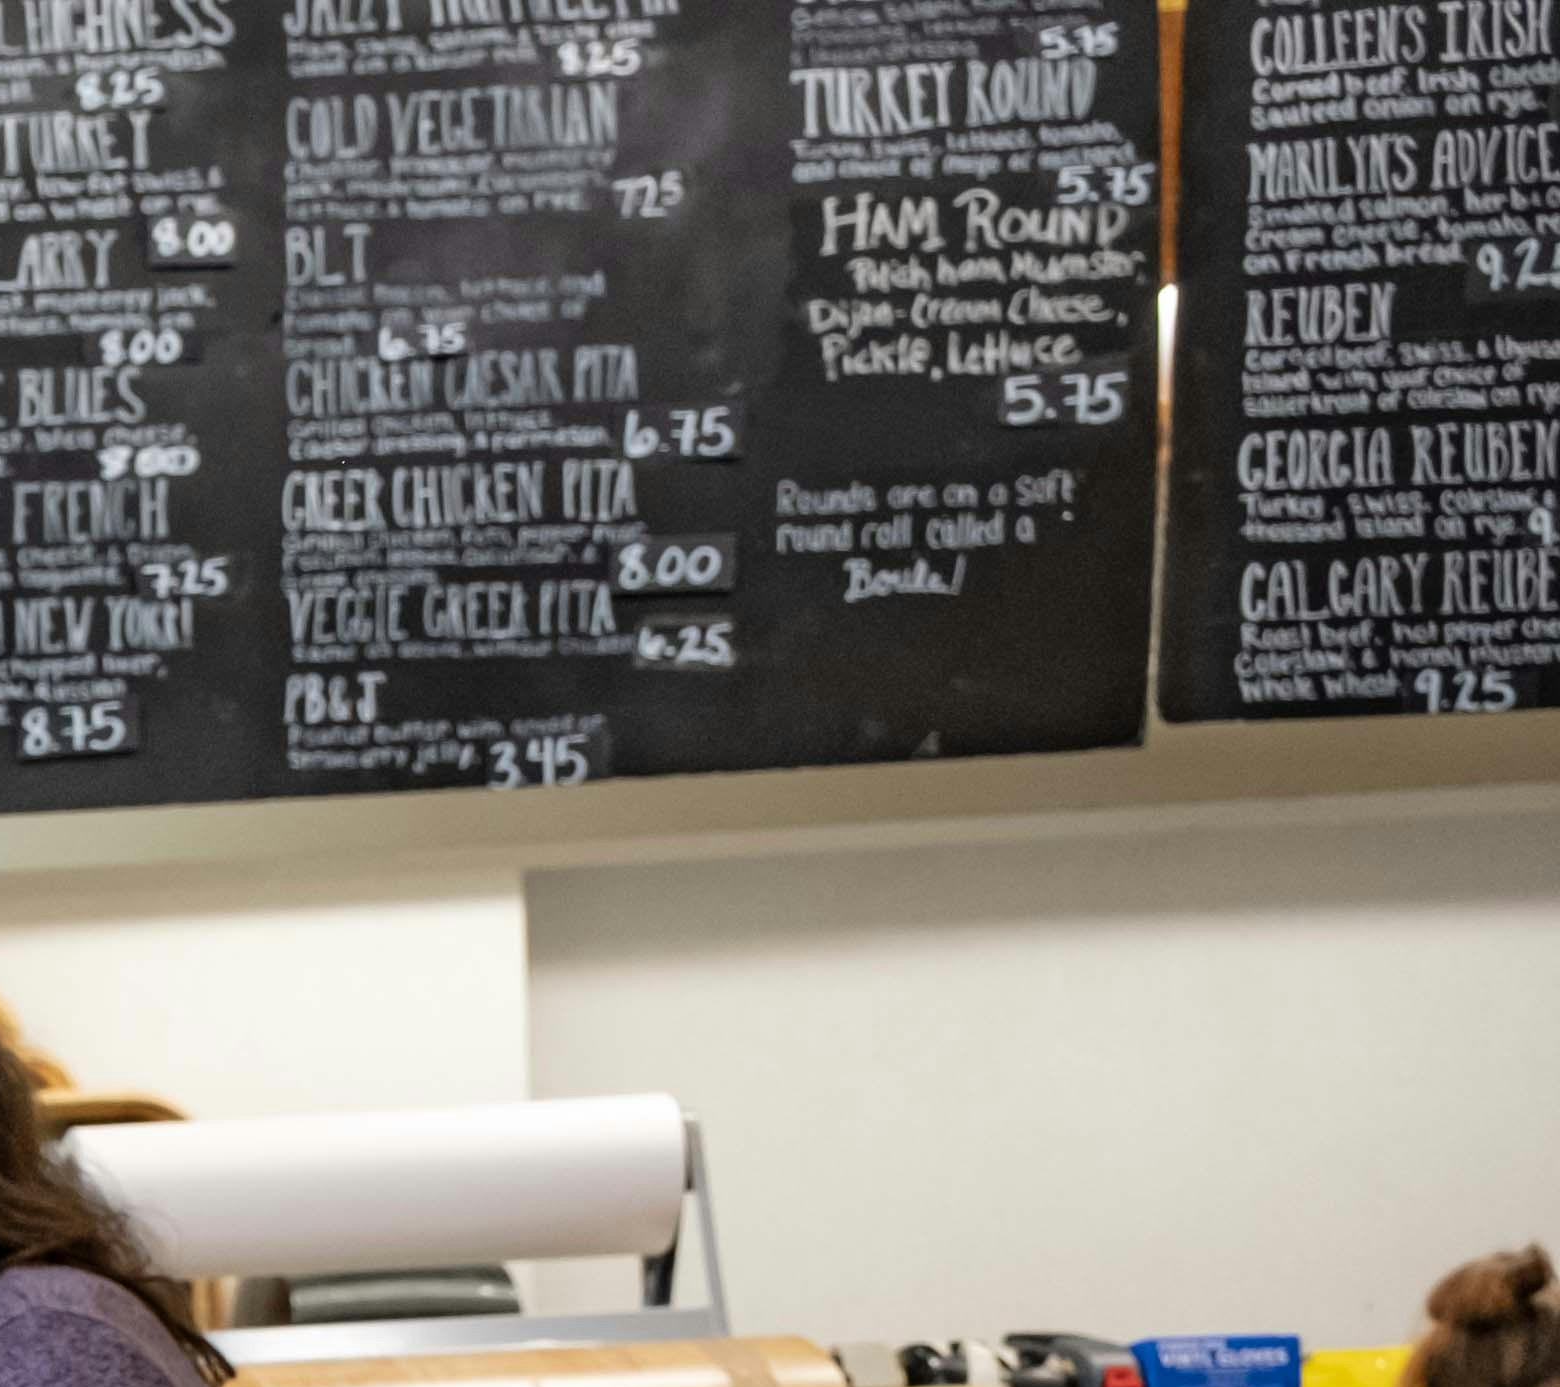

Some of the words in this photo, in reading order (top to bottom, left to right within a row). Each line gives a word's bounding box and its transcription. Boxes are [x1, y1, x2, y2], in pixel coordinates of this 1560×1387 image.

[24, 0, 236, 56] HIGHNESS
[1438, 0, 1555, 63] IRISH
[286, 94, 378, 160] COLD
[384, 81, 618, 156] VEGETARIAN
[789, 61, 957, 139] TURKEY
[965, 56, 1098, 128] ROUND
[1056, 162, 1157, 206] 5.75
[820, 192, 947, 257] HAM
[952, 187, 1131, 254] ROUND
[935, 253, 1008, 288] ham
[1243, 281, 1398, 348] REUBEN
[19, 366, 147, 429] BLUES
[286, 354, 435, 416] CHICKEN
[572, 342, 639, 402] PITA
[1002, 371, 1128, 427] 5.75
[1236, 425, 1395, 491] GEORGIA
[1409, 418, 1560, 486] REUBEN
[12, 479, 170, 544] FRENCH
[392, 459, 546, 528] CHICKEN
[562, 457, 638, 523] PITA
[775, 477, 878, 516] Rounds
[887, 483, 938, 509] are
[942, 482, 979, 508] on
[988, 482, 1009, 506] a
[775, 518, 854, 556] round
[860, 513, 913, 551] roll
[926, 510, 1006, 551] called
[1015, 514, 1037, 544] a
[285, 588, 410, 646] VEGGIE
[538, 578, 617, 638] PITA
[1239, 551, 1430, 623] CALGARY
[1439, 546, 1560, 615] REUBE
[16, 597, 95, 654] NEW
[1413, 667, 1518, 715] 9.25
